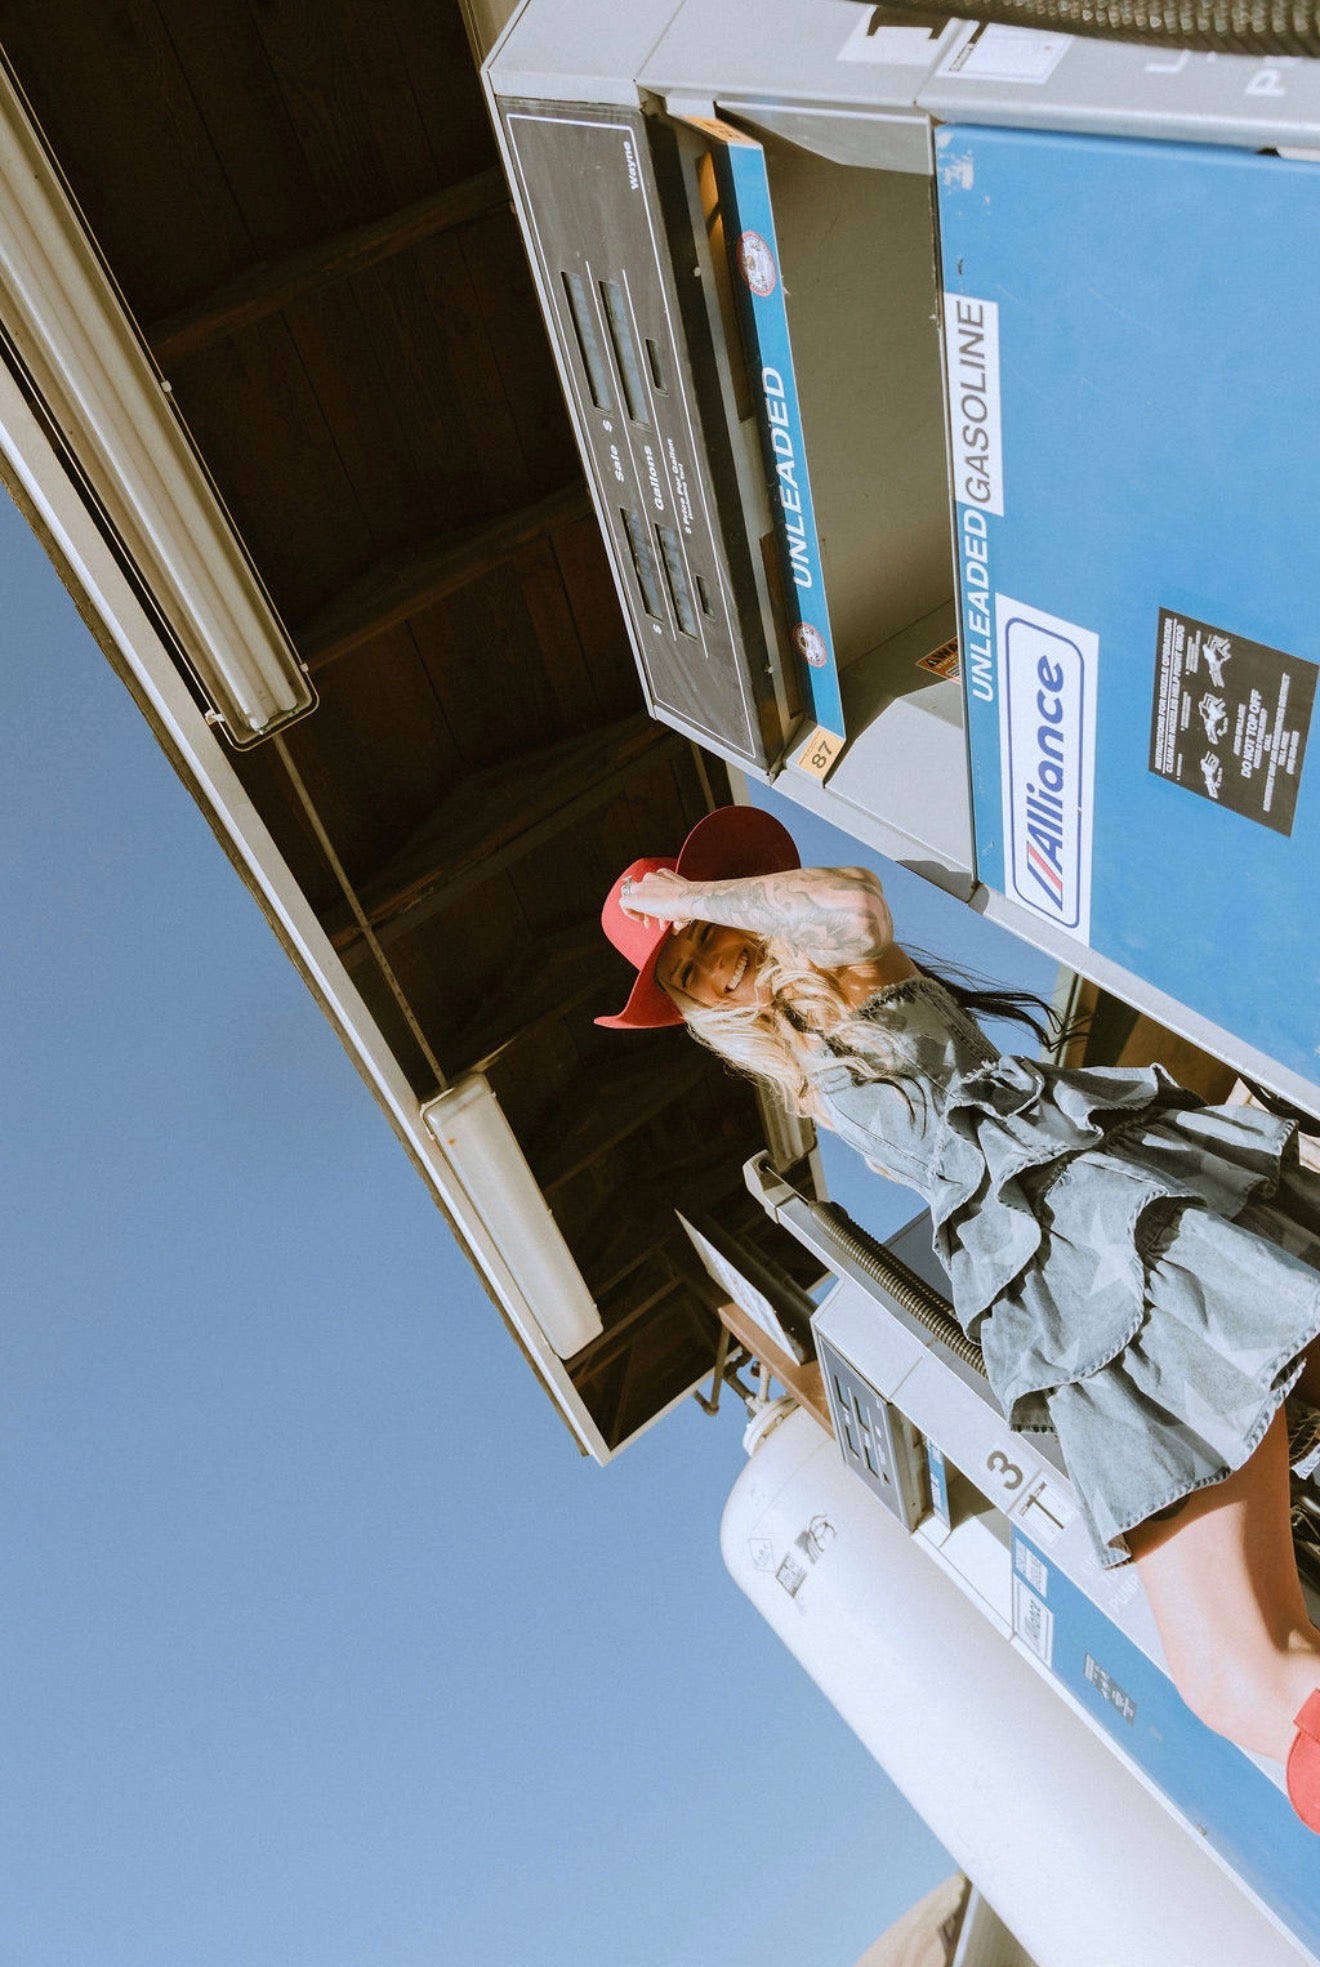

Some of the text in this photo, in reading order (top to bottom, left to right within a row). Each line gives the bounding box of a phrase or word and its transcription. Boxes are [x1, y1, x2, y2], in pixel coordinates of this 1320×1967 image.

[623, 141, 639, 190] Wayne
[956, 300, 991, 503] GASOLINE
[610, 444, 624, 482] Sale
[644, 445, 664, 511] Gallons
[667, 438, 679, 474] Gallon
[762, 366, 812, 588] UNLEADED
[675, 475, 684, 495] Per
[680, 497, 690, 525] Price
[963, 509, 994, 702] UNLEADED
[811, 740, 832, 769] 87
[1240, 688, 1261, 778] DO NOT TOP OFF
[1026, 655, 1064, 876] Alliance
[986, 1450, 1024, 1491] 3
